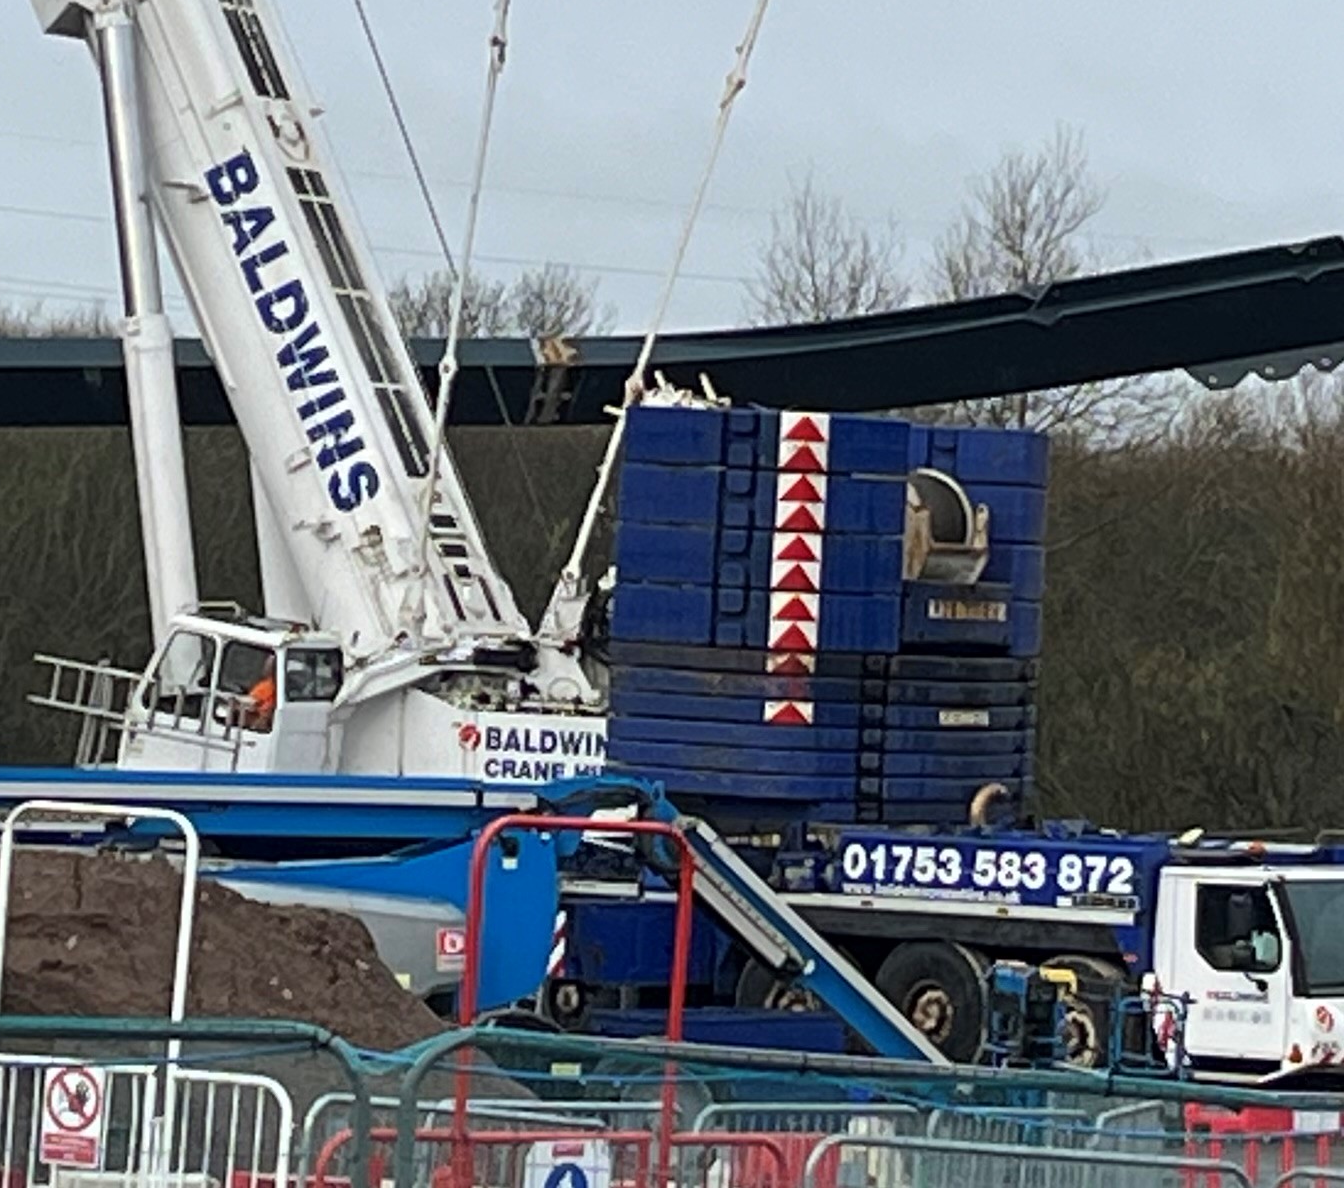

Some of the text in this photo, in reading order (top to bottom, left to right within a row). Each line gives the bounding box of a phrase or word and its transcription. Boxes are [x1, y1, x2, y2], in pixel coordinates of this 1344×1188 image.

[204, 150, 381, 513] BALDWINS
[485, 726, 608, 757] BALDWIN
[484, 758, 565, 781] CRANE
[843, 843, 962, 885] 01753
[972, 849, 1047, 890] 583
[1057, 853, 1134, 894] 872
